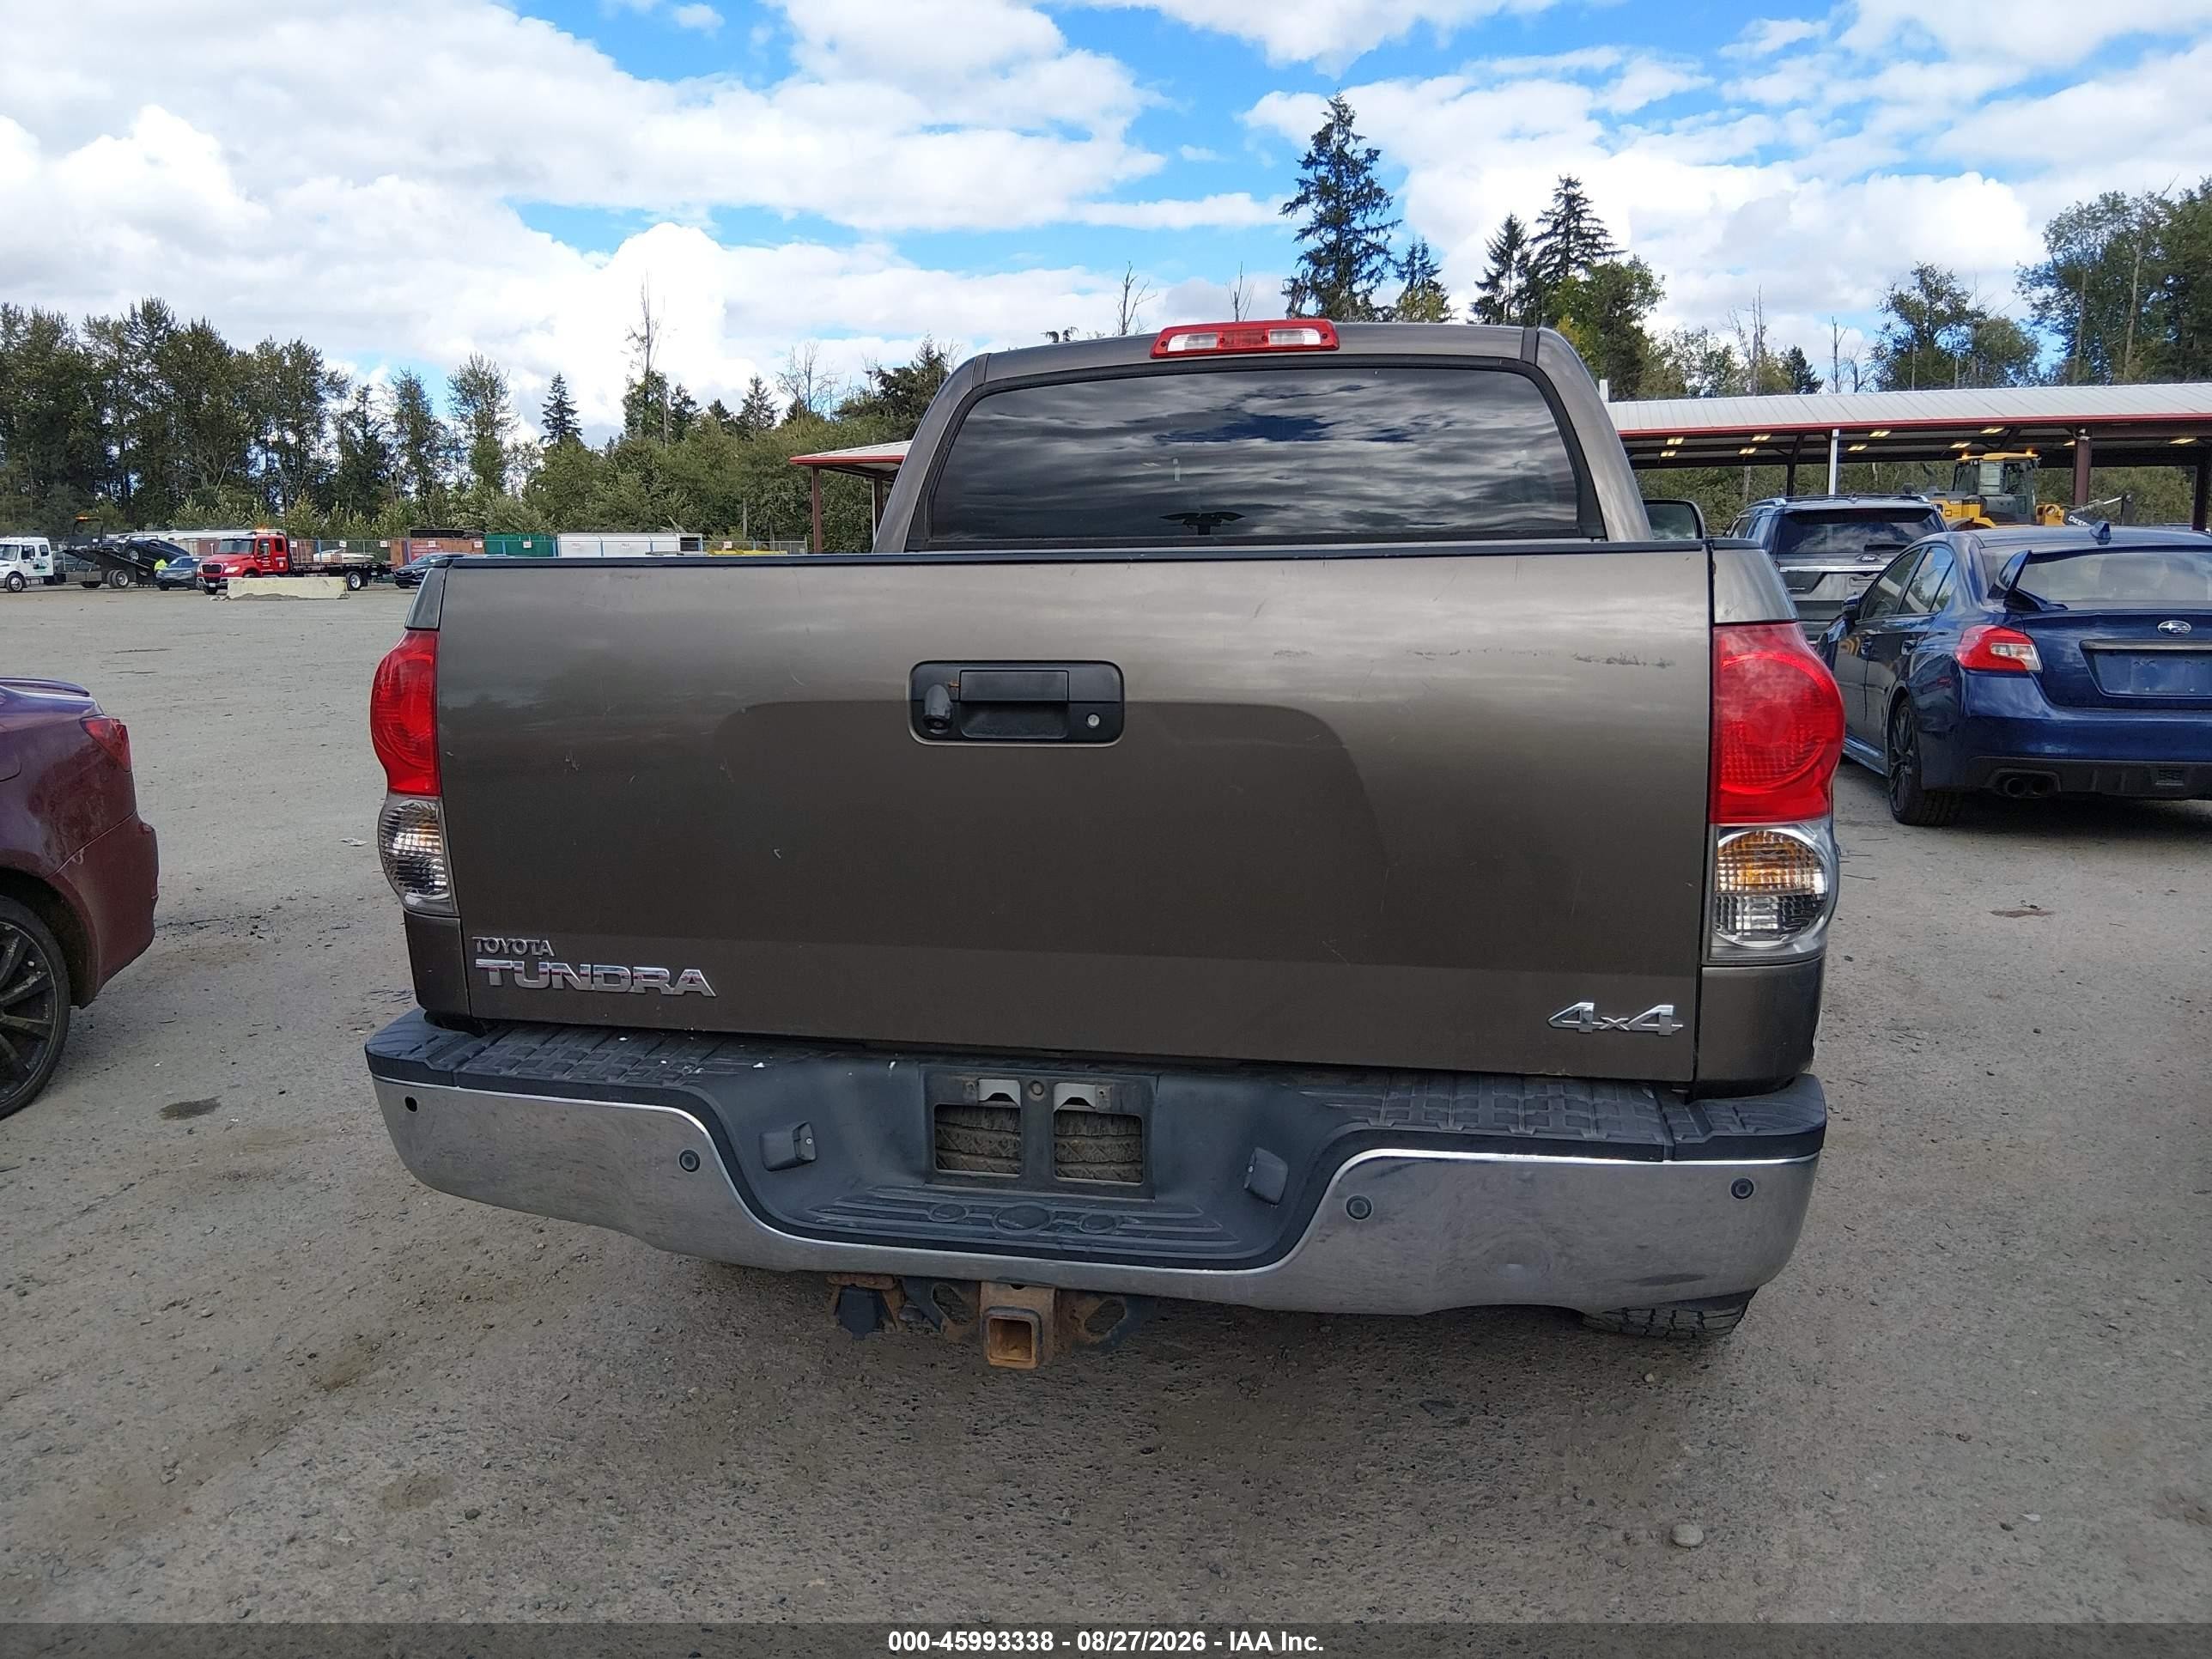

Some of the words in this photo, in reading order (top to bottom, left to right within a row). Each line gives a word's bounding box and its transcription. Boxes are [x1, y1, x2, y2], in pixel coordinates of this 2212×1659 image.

[472, 936, 555, 957] TOYOTA
[475, 958, 717, 997] TUNDRA
[1547, 1001, 1684, 1036] 4x4
